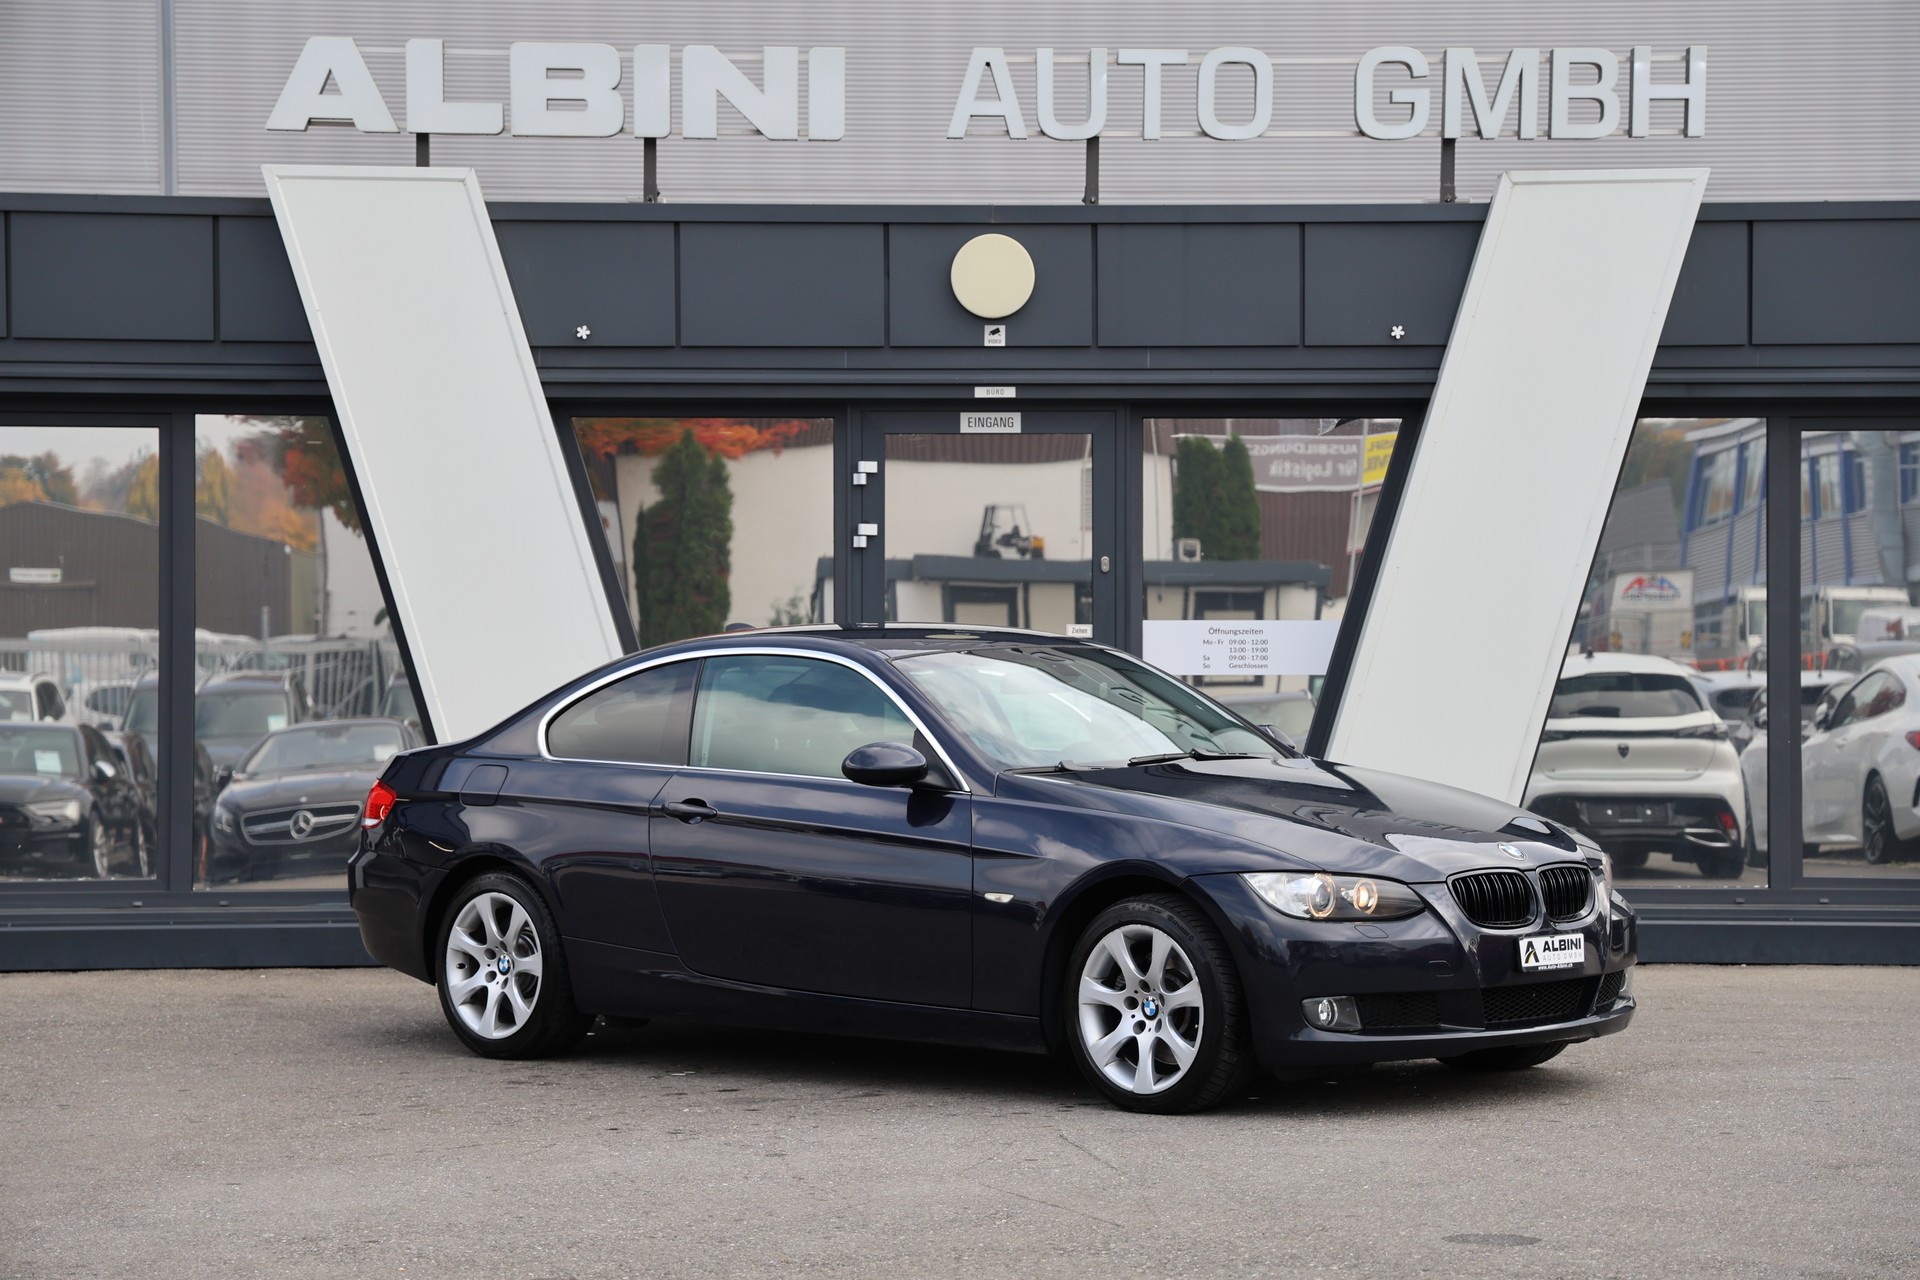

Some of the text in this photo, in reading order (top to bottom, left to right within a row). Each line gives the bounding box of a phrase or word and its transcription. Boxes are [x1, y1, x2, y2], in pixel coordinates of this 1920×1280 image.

[265, 35, 1707, 141] ALBINI AUTO GMBH
[986, 387, 1005, 395] BÜRO
[967, 416, 1014, 428] EINGANG
[1208, 626, 1263, 636] Öffnungszeiten
[1543, 938, 1581, 952] ALBINI
[1543, 952, 1582, 962] AUTO GMBH
